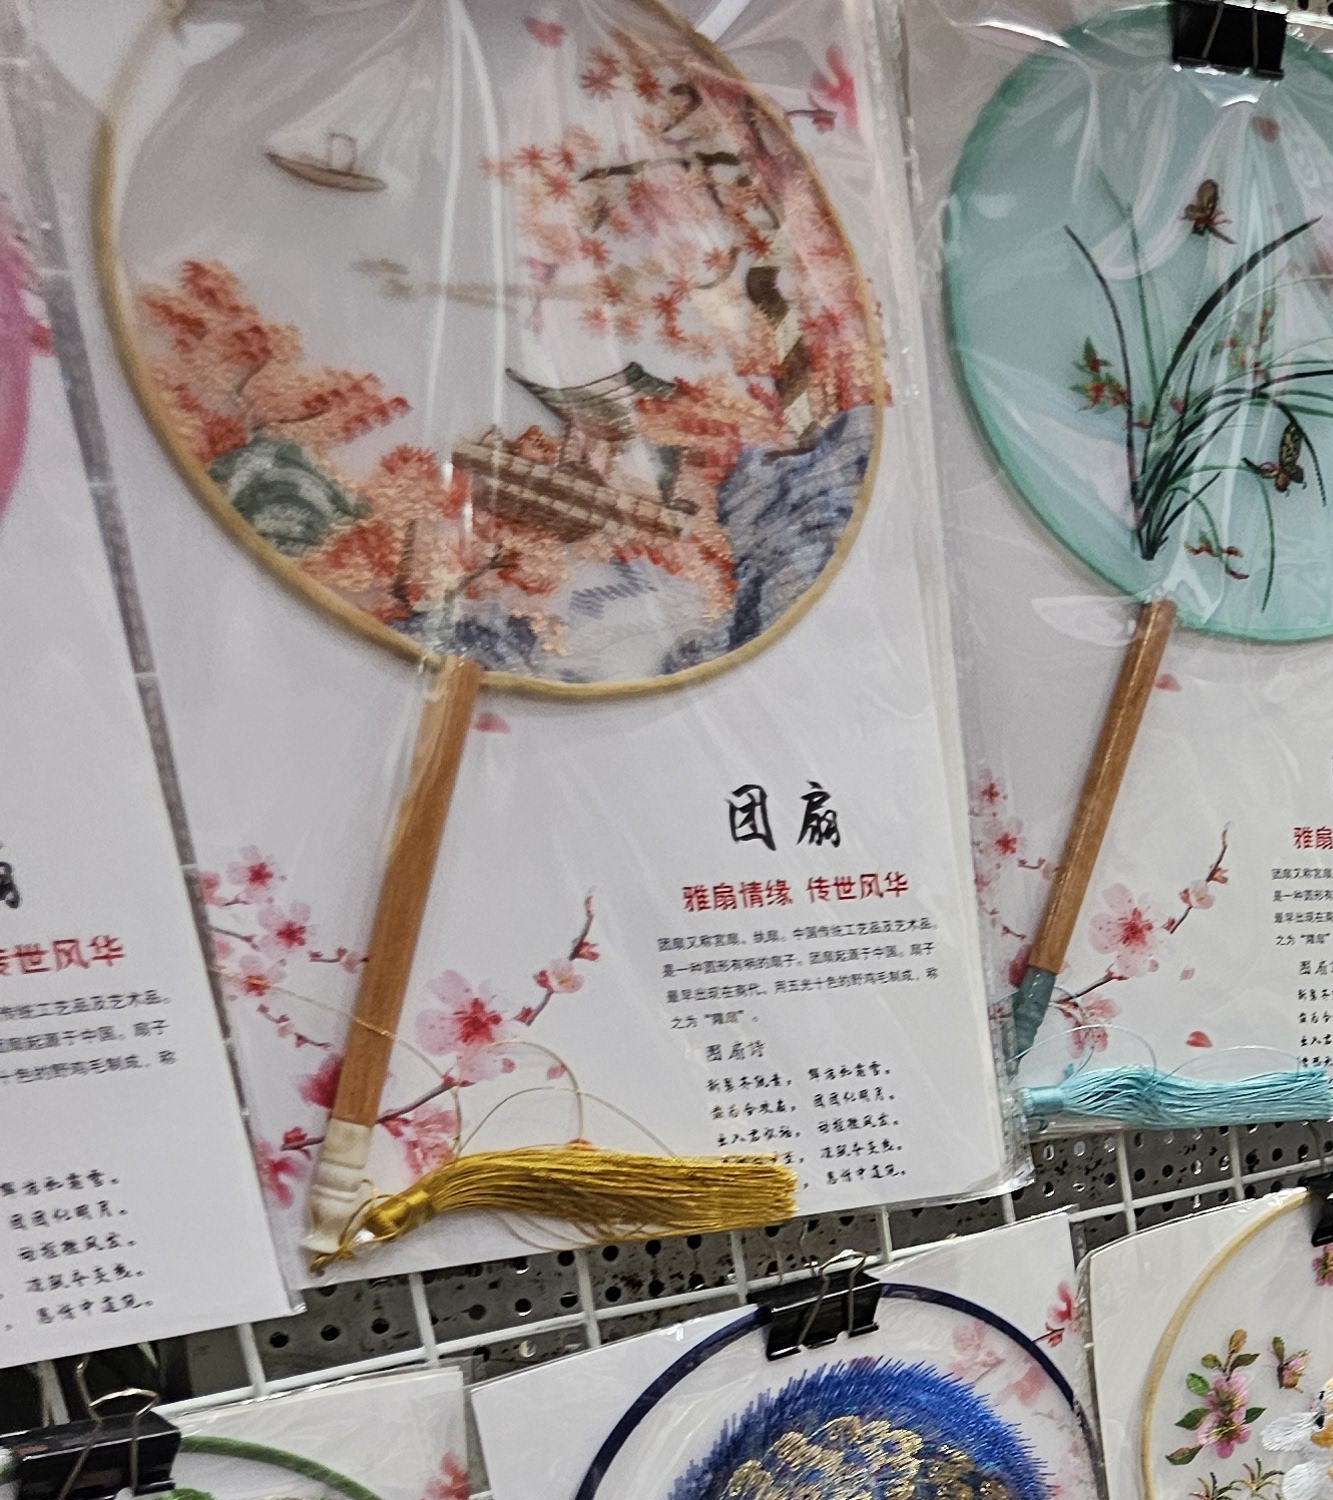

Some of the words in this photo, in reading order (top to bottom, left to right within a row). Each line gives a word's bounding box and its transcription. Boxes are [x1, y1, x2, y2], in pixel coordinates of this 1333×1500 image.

[725, 779, 842, 852] 团扇
[681, 879, 793, 912] 雅扇情缘
[806, 871, 909, 904] 传世风华
